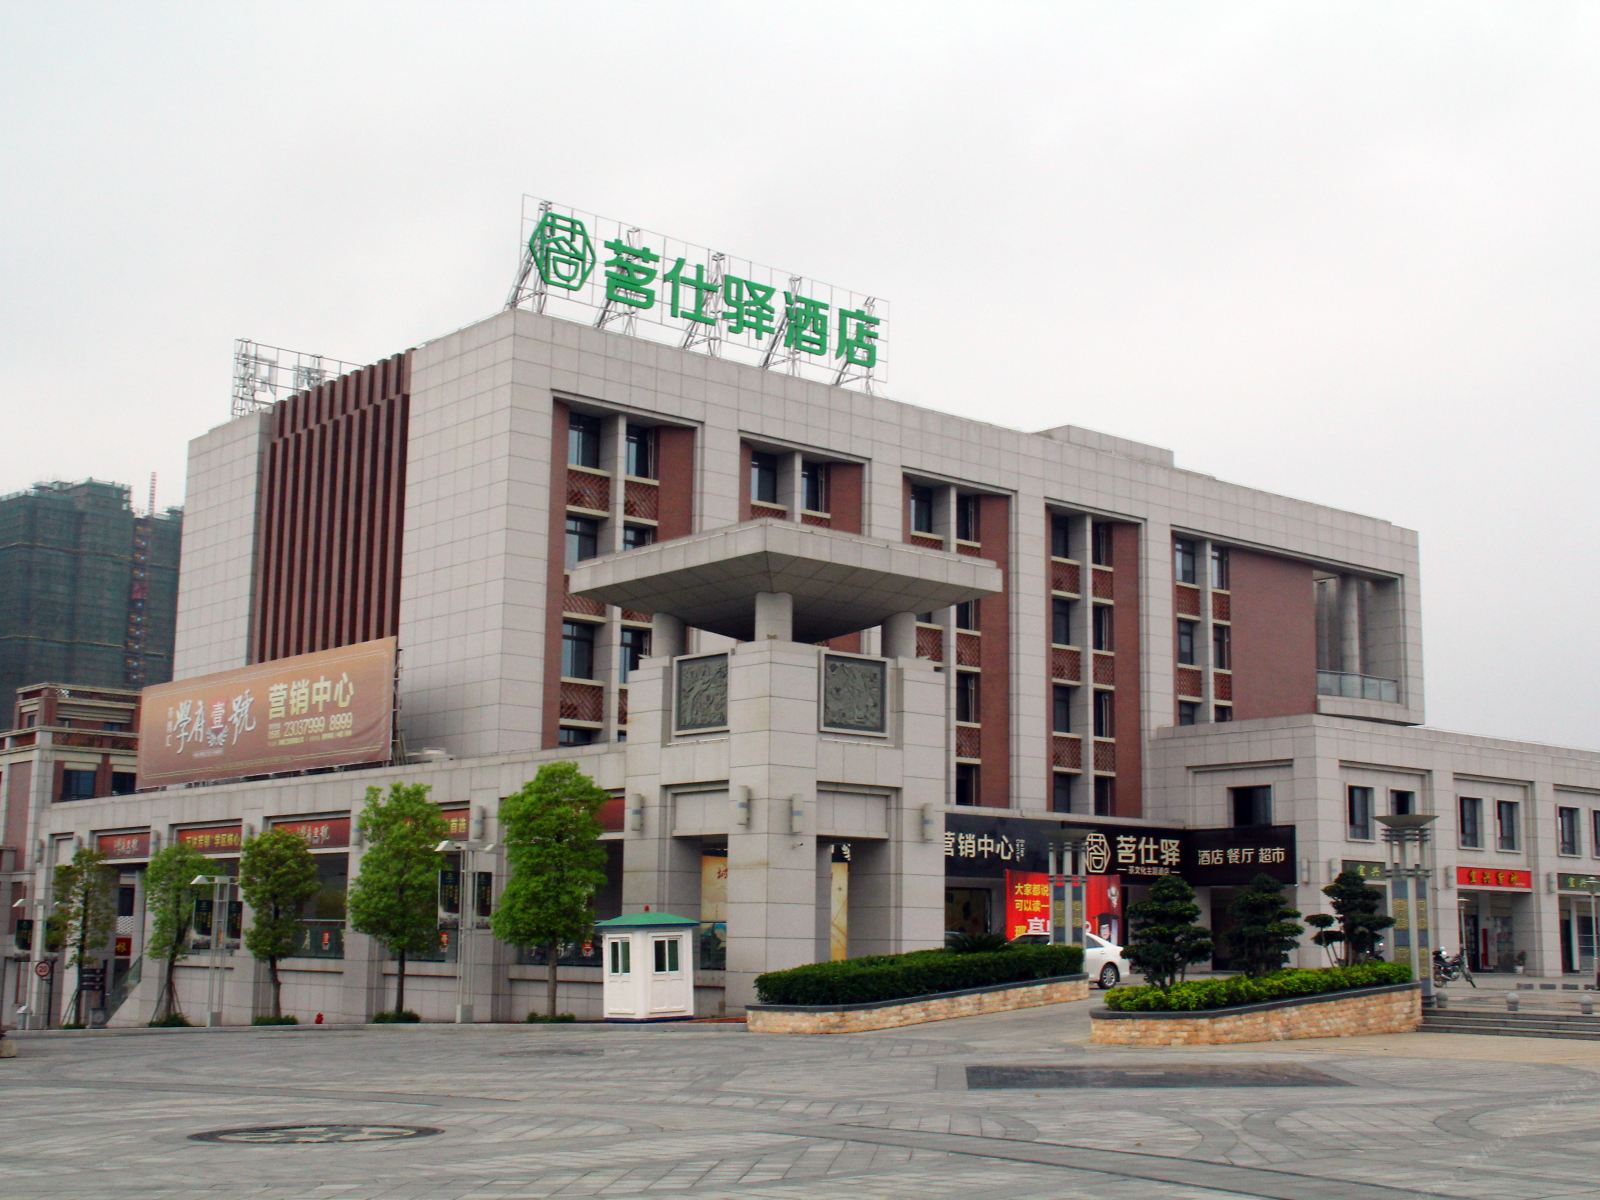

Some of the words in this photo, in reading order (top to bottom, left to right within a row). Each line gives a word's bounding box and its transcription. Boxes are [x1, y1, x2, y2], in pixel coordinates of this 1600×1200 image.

[604, 238, 881, 369] 茗仕驿酒店
[268, 672, 355, 720] 营销中心
[944, 831, 1014, 861] 营销中心
[1116, 835, 1181, 866] 茗仕驿
[1198, 849, 1224, 866] 酒店
[1226, 848, 1255, 864] 餐厅
[1258, 847, 1286, 864] 超市
[1014, 883, 1049, 896] 大家都说
